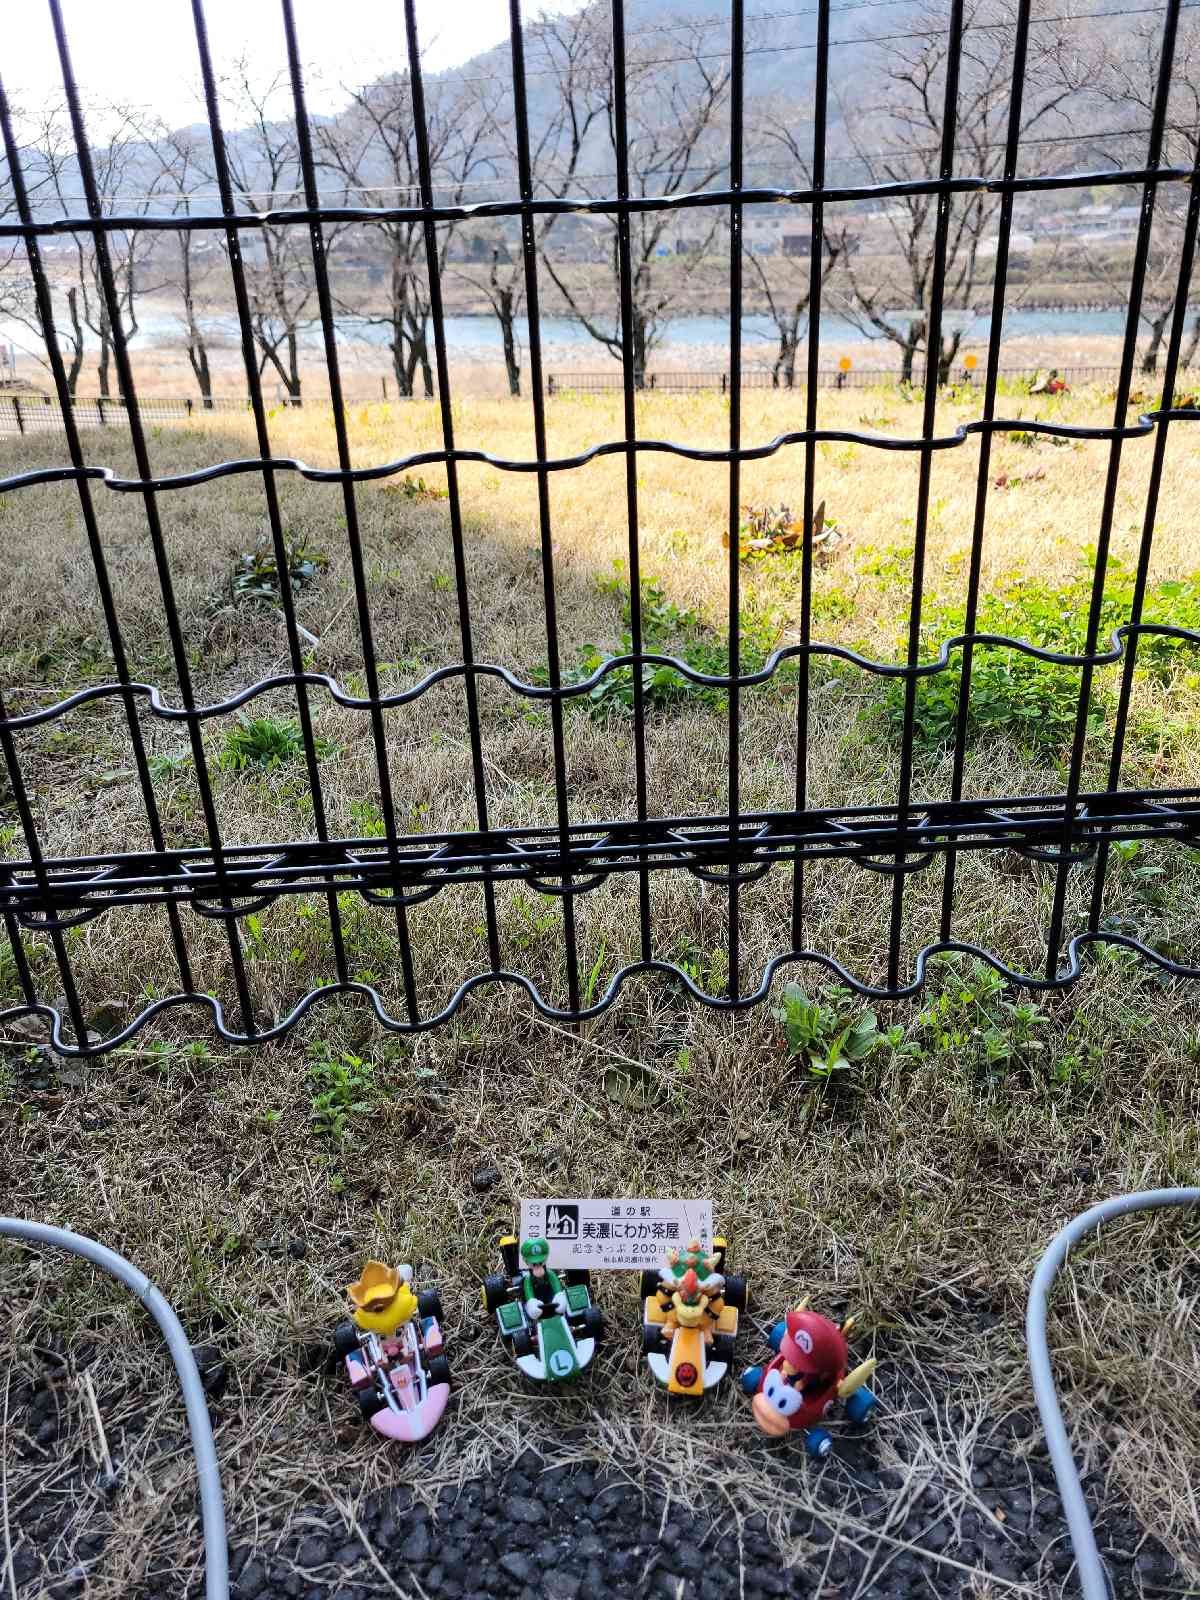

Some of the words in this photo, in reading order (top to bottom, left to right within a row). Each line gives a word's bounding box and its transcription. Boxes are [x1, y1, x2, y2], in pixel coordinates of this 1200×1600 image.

[529, 1204, 541, 1217] 23
[611, 1206, 651, 1217] 道の駅
[582, 1222, 680, 1240] 美濃にわか茶屋
[554, 1355, 568, 1371] L
